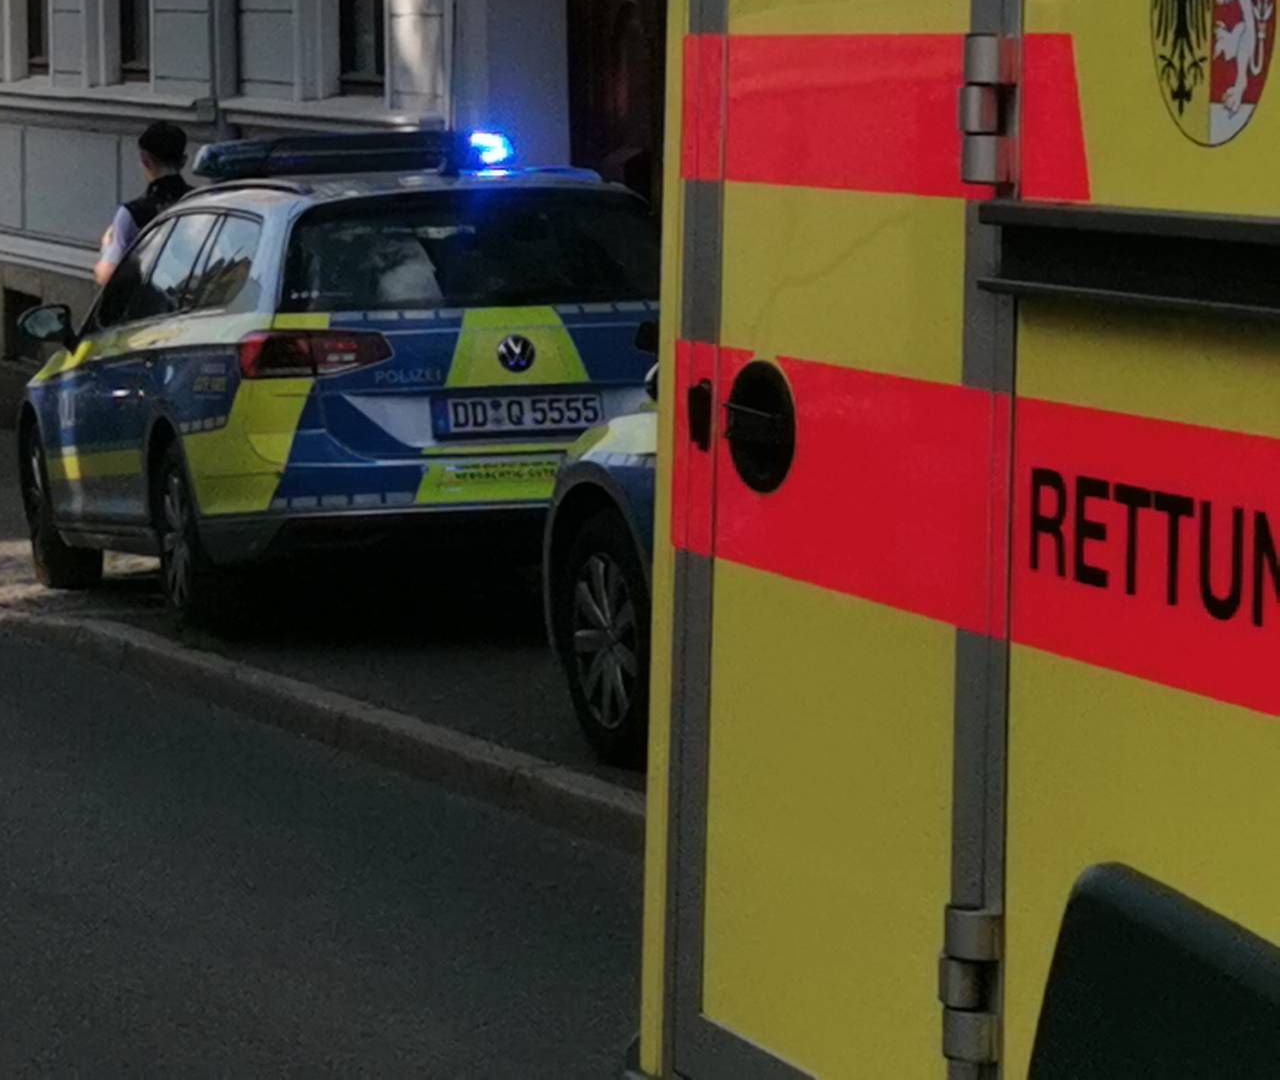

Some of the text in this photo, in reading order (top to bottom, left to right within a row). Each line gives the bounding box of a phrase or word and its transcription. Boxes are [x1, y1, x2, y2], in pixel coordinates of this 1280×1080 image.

[374, 367, 441, 384] POLIZEI
[451, 396, 600, 429] DD Q 5555
